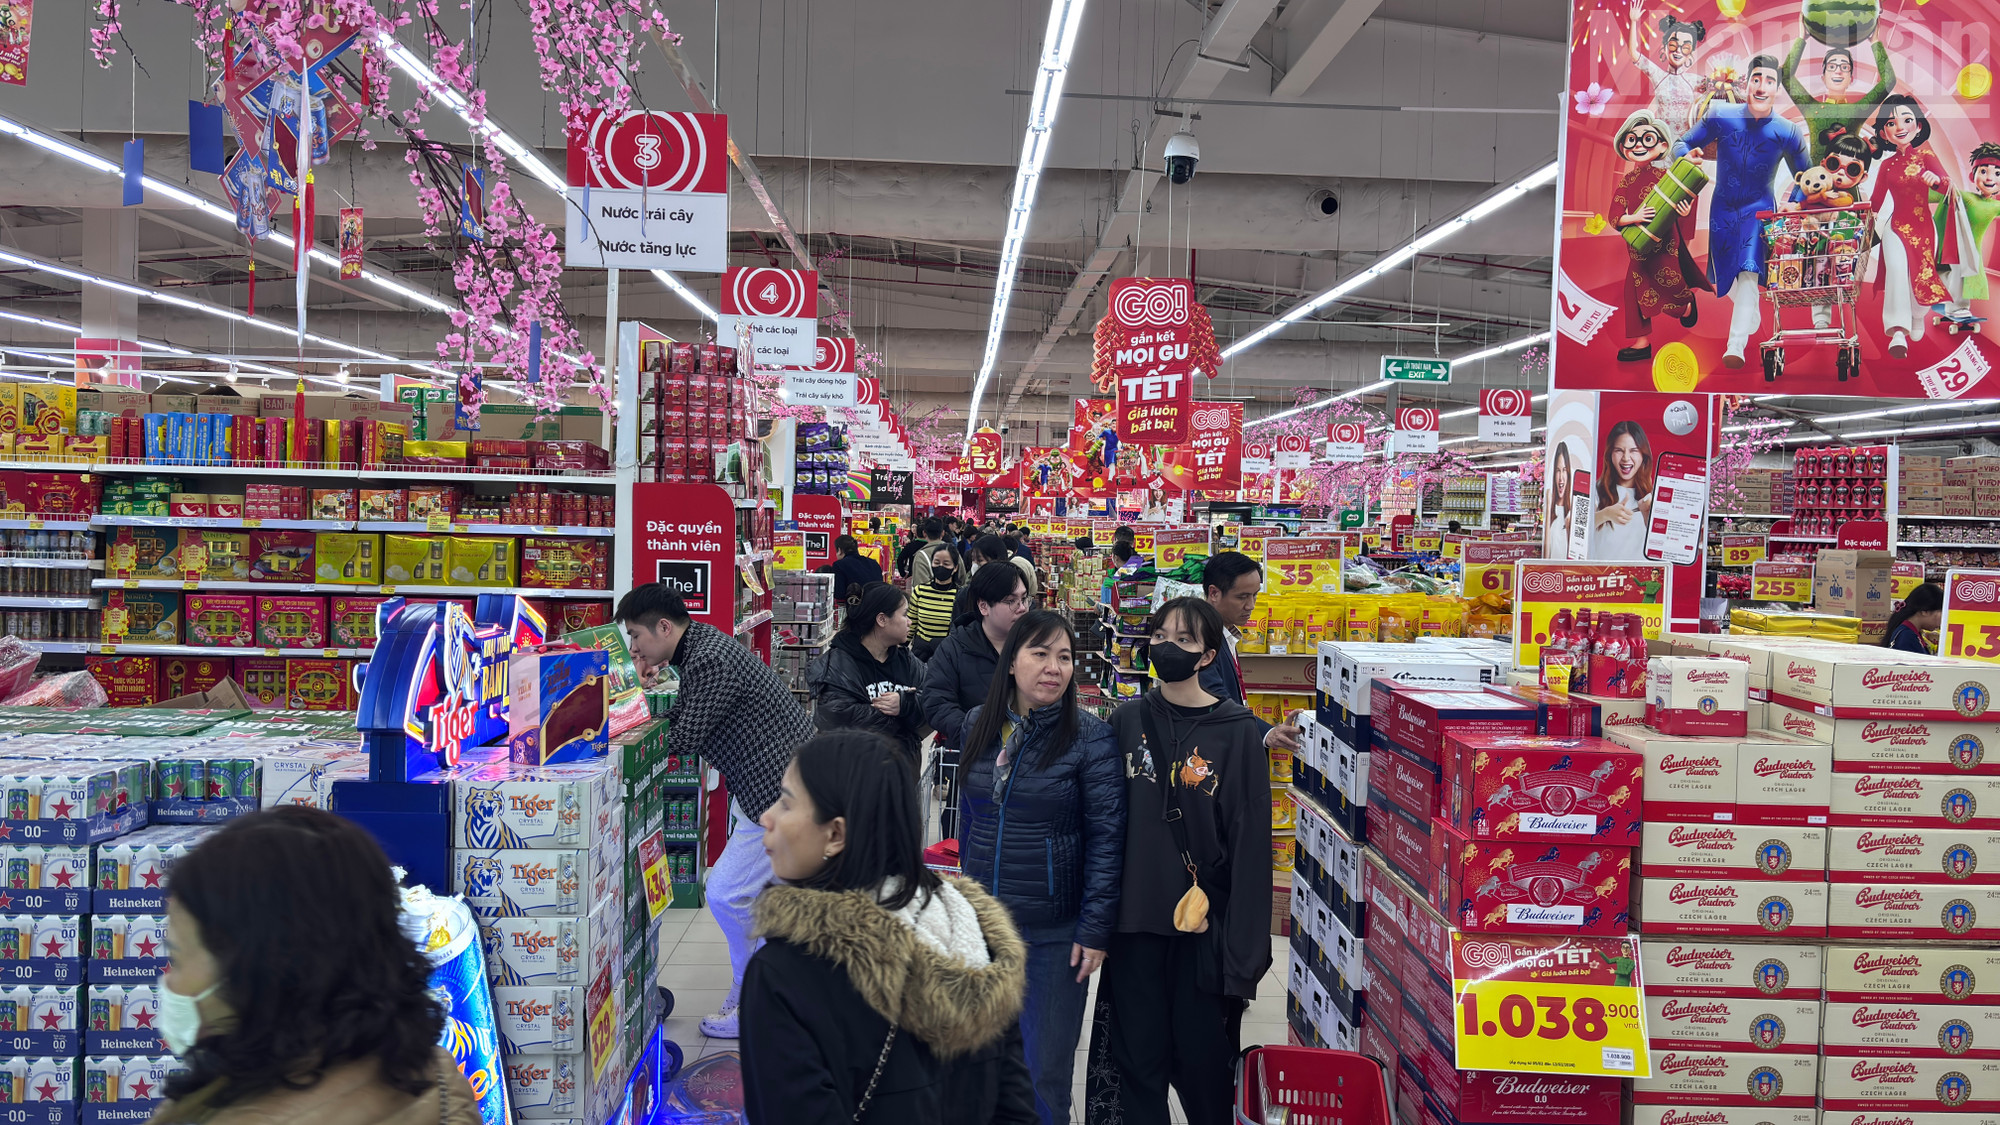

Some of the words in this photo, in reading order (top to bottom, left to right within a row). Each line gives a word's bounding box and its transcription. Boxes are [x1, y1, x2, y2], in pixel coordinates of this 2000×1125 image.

[634, 134, 662, 170] 3
[602, 206, 639, 219] Nước
[669, 209, 694, 223] cây
[600, 240, 637, 253] Nước
[640, 242, 672, 256] tăng
[675, 243, 697, 258] lực
[759, 283, 779, 304] 4
[1115, 285, 1189, 326] GO!
[765, 325, 780, 334] các
[782, 326, 798, 335] loại
[1157, 330, 1175, 343] kết
[773, 346, 790, 356] loại
[816, 348, 826, 362] 5
[1116, 347, 1154, 367] MỌI
[1159, 343, 1189, 360] GU
[1408, 371, 1425, 379] EXIT
[1936, 357, 1969, 392] 29
[808, 377, 818, 385] cây
[819, 377, 836, 386] đóng
[1121, 364, 1183, 402] TẾT
[811, 392, 820, 400] cây
[1498, 397, 1513, 410] 17
[1128, 405, 1148, 421] Giá
[1150, 405, 1178, 417] luôn
[1191, 408, 1230, 430] GO!
[1670, 418, 1686, 426] The
[1685, 411, 1691, 424] 1
[1130, 419, 1152, 434] bất
[1154, 417, 1174, 430] bại
[1410, 414, 1424, 426] 16
[1340, 429, 1351, 438] 15
[1192, 439, 1212, 449] MỌI
[1213, 437, 1229, 446] GU
[1288, 440, 1298, 448] 14
[1195, 447, 1226, 466] TẾT
[1949, 494, 1970, 502] VIFON
[798, 512, 812, 521] Đặc
[813, 512, 835, 521] quyền
[1945, 508, 1972, 516] VIFON
[646, 520, 674, 535] Đặc
[678, 520, 722, 535] quyền
[798, 521, 818, 529] thành
[819, 521, 835, 529] viên
[1051, 524, 1066, 532] 149
[1068, 528, 1087, 537] 289
[647, 539, 687, 552] thành
[691, 540, 721, 552] viên
[806, 539, 821, 548] The
[821, 536, 826, 549] 1
[1305, 542, 1322, 553] TẾT
[1419, 540, 1432, 548] 63
[1844, 539, 1859, 548] Đặc
[1859, 539, 1882, 548] quyền
[1509, 547, 1526, 557] TẾT
[1729, 549, 1750, 561] 89
[662, 576, 694, 593] The
[694, 568, 702, 593] 1
[1280, 564, 1313, 586] 35
[1482, 568, 1511, 591] 61
[1581, 574, 1593, 583] kết
[1596, 570, 1628, 589] TẾT
[1523, 571, 1564, 594] GO!
[1566, 585, 1583, 593] MỌI
[1584, 584, 1596, 592] GU
[1756, 580, 1796, 596] 255
[1956, 580, 1996, 603] GO!
[1862, 667, 1934, 690] Budweiser
[1891, 680, 1932, 693] Budvar
[1897, 698, 1922, 706] LAGER
[429, 691, 479, 767] Tiger
[1861, 721, 1930, 743] Budweiser
[591, 742, 608, 752] Tiger
[1890, 735, 1929, 746] Budvar
[1660, 753, 1722, 771] Budweiser
[1686, 766, 1720, 776] Budvar
[157, 807, 194, 816] Heineken
[215, 807, 228, 817] 0.0
[509, 794, 556, 817] Tiger
[1527, 815, 1588, 830] Budweiser
[24, 825, 42, 838] 0.0
[1668, 825, 1737, 847] Budweiser
[1697, 839, 1735, 850] Budvar
[510, 862, 557, 883] Tiger
[647, 867, 666, 905] 436
[109, 897, 162, 908] Heineken
[1515, 907, 1575, 922] Budweiser
[1461, 940, 1512, 968] GO!
[1554, 942, 1592, 965] TẾT
[1666, 945, 1735, 968] Budweiser
[1538, 958, 1553, 968] GU
[1694, 958, 1733, 970] Budvar
[103, 966, 156, 977] Heineken
[1455, 992, 1608, 1042] 1.038
[1605, 1004, 1640, 1019] .900
[1623, 1021, 1640, 1030] vnd
[591, 1016, 611, 1072] 329
[1466, 1071, 1476, 1079] 24
[1850, 1060, 1918, 1082] Budweiser
[1492, 1075, 1591, 1095] Budweiser
[1879, 1073, 1917, 1084] Budvar
[1534, 1095, 1547, 1104] 0.0
